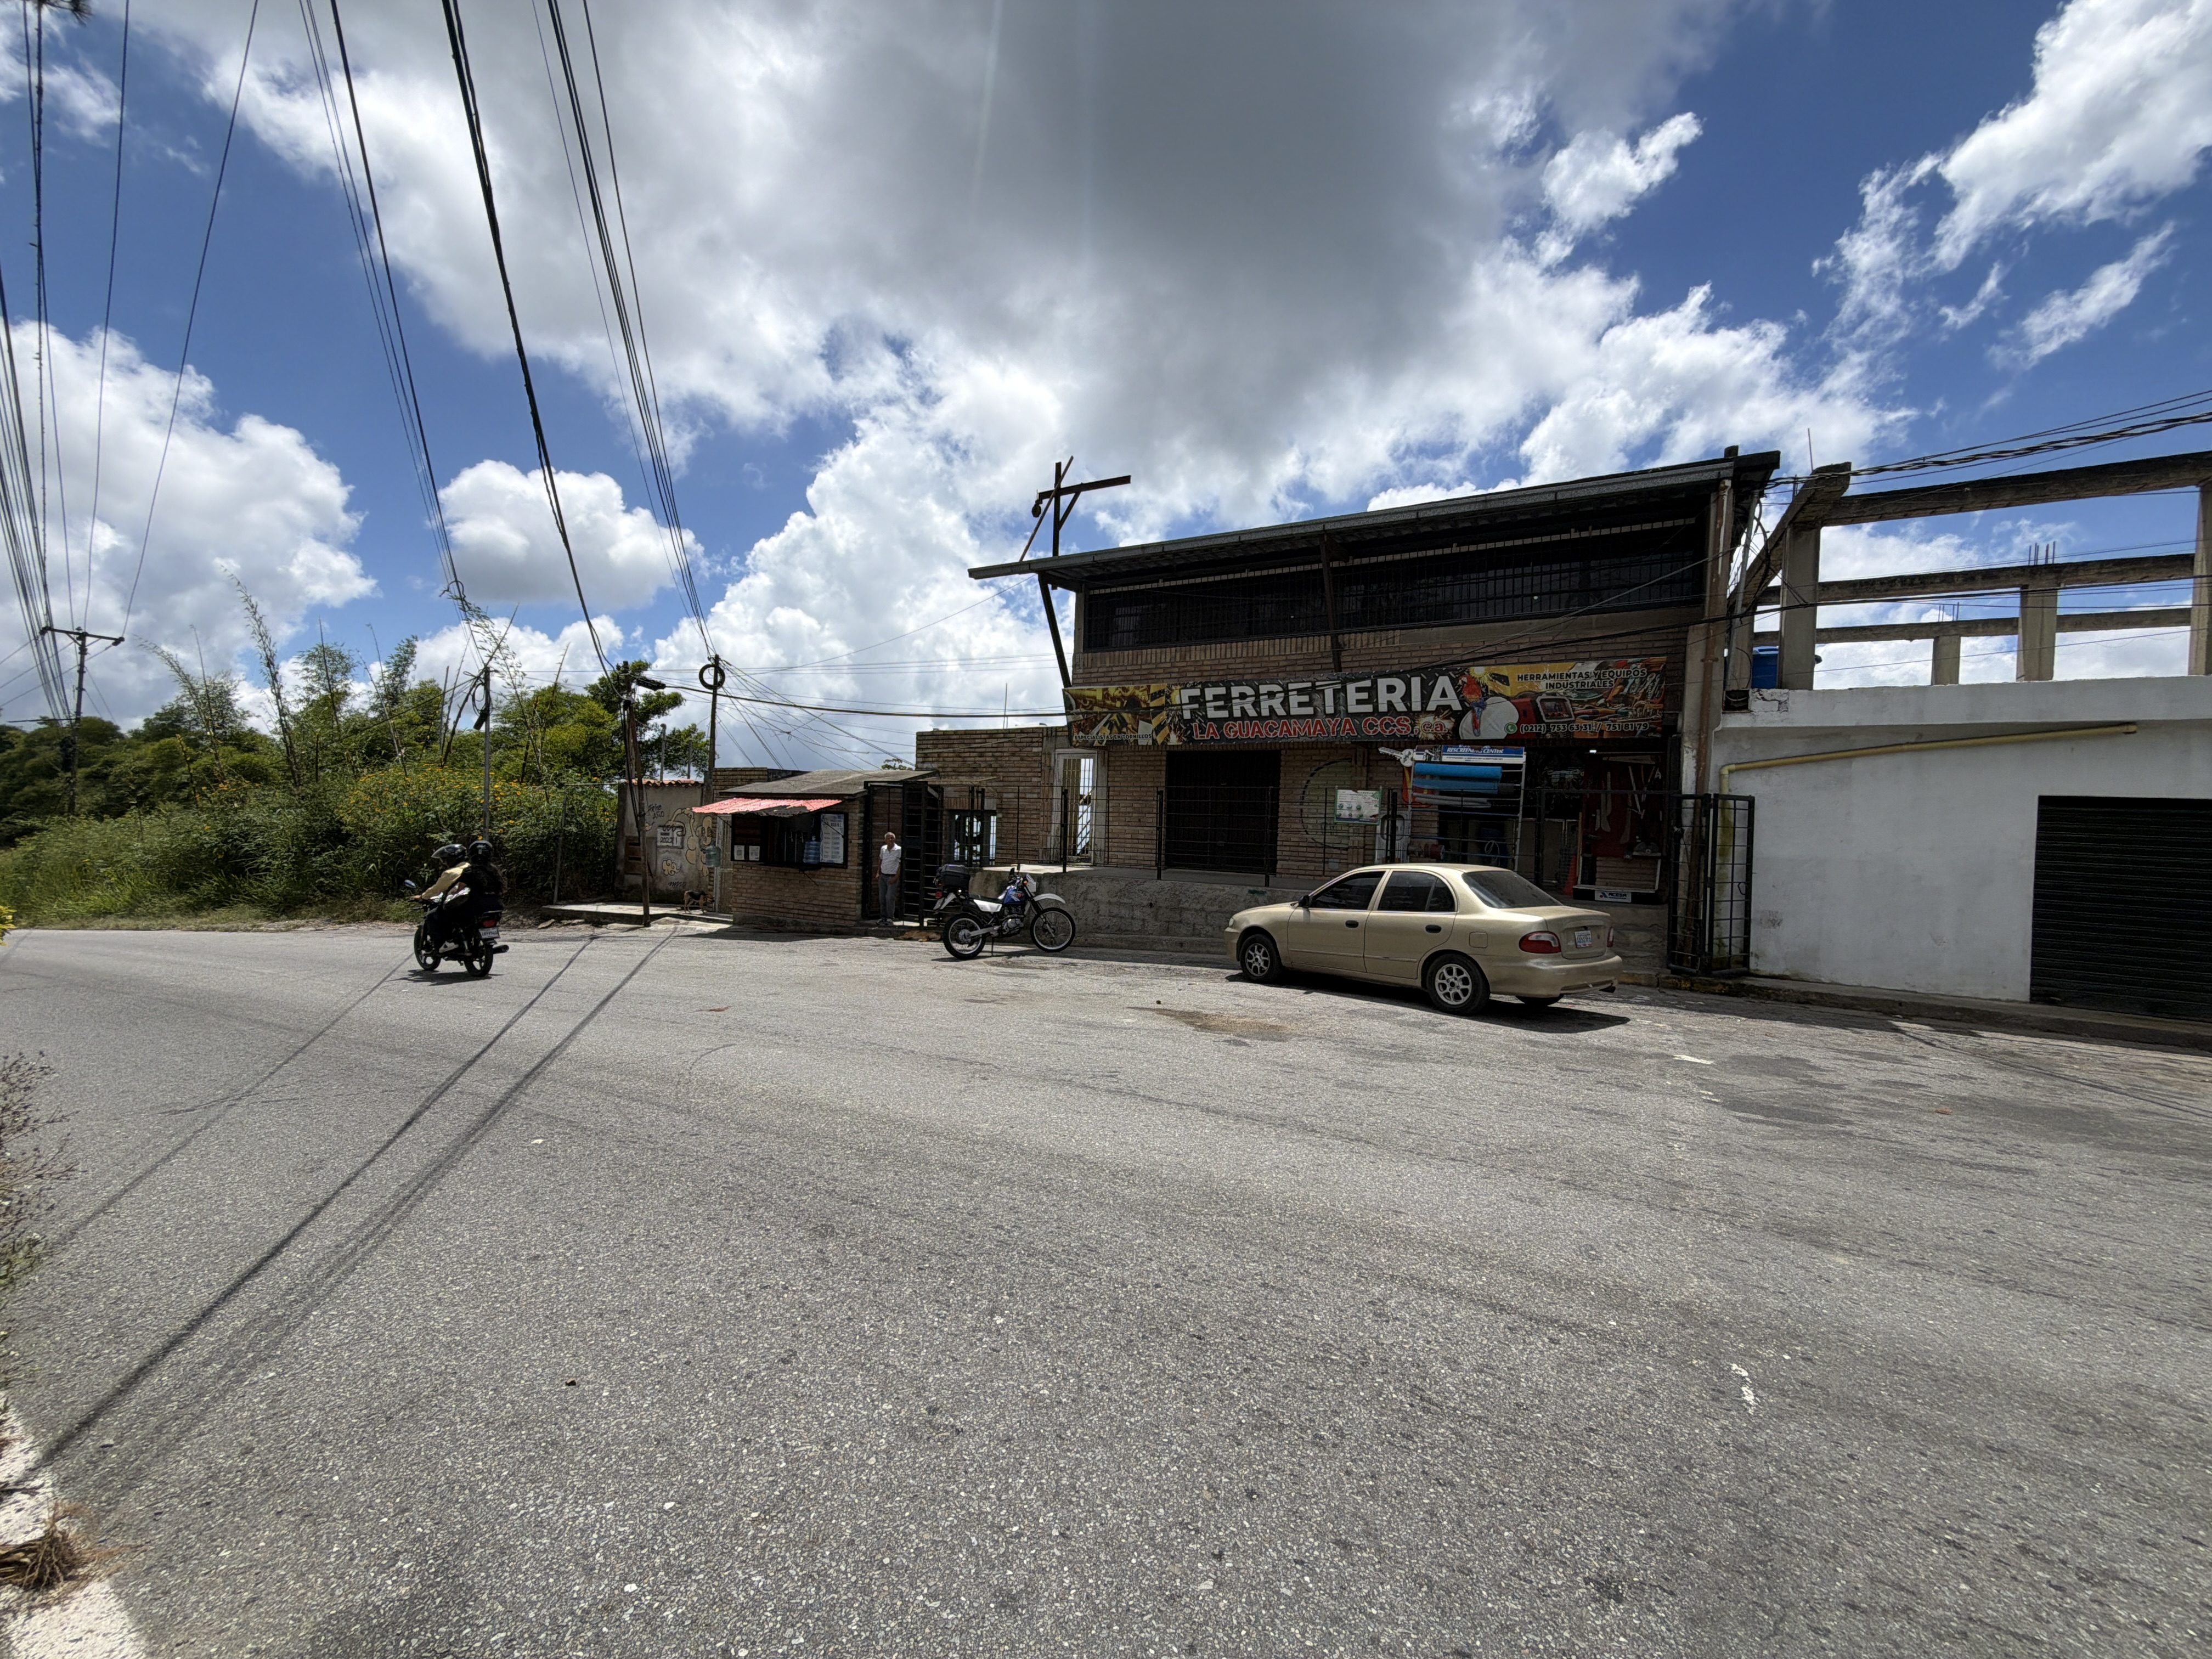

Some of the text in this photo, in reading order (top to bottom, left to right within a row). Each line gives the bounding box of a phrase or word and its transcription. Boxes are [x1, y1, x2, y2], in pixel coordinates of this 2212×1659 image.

[1517, 671, 1590, 681] HERRAMIENTAS
[1601, 668, 1646, 678] EQUIPOS
[1545, 680, 1615, 690] INDUSTRIALES
[1180, 676, 1463, 719] FERRETERIA
[1193, 722, 1220, 740] LA
[1223, 718, 1357, 739] GUACAMAYA
[1520, 723, 1547, 733] (0212)
[1550, 723, 1567, 732] 753
[1568, 723, 1582, 731] 63
[1582, 723, 1592, 731] 31
[1606, 722, 1622, 731] 751
[1623, 723, 1634, 731] 81
[1637, 722, 1649, 730] 79
